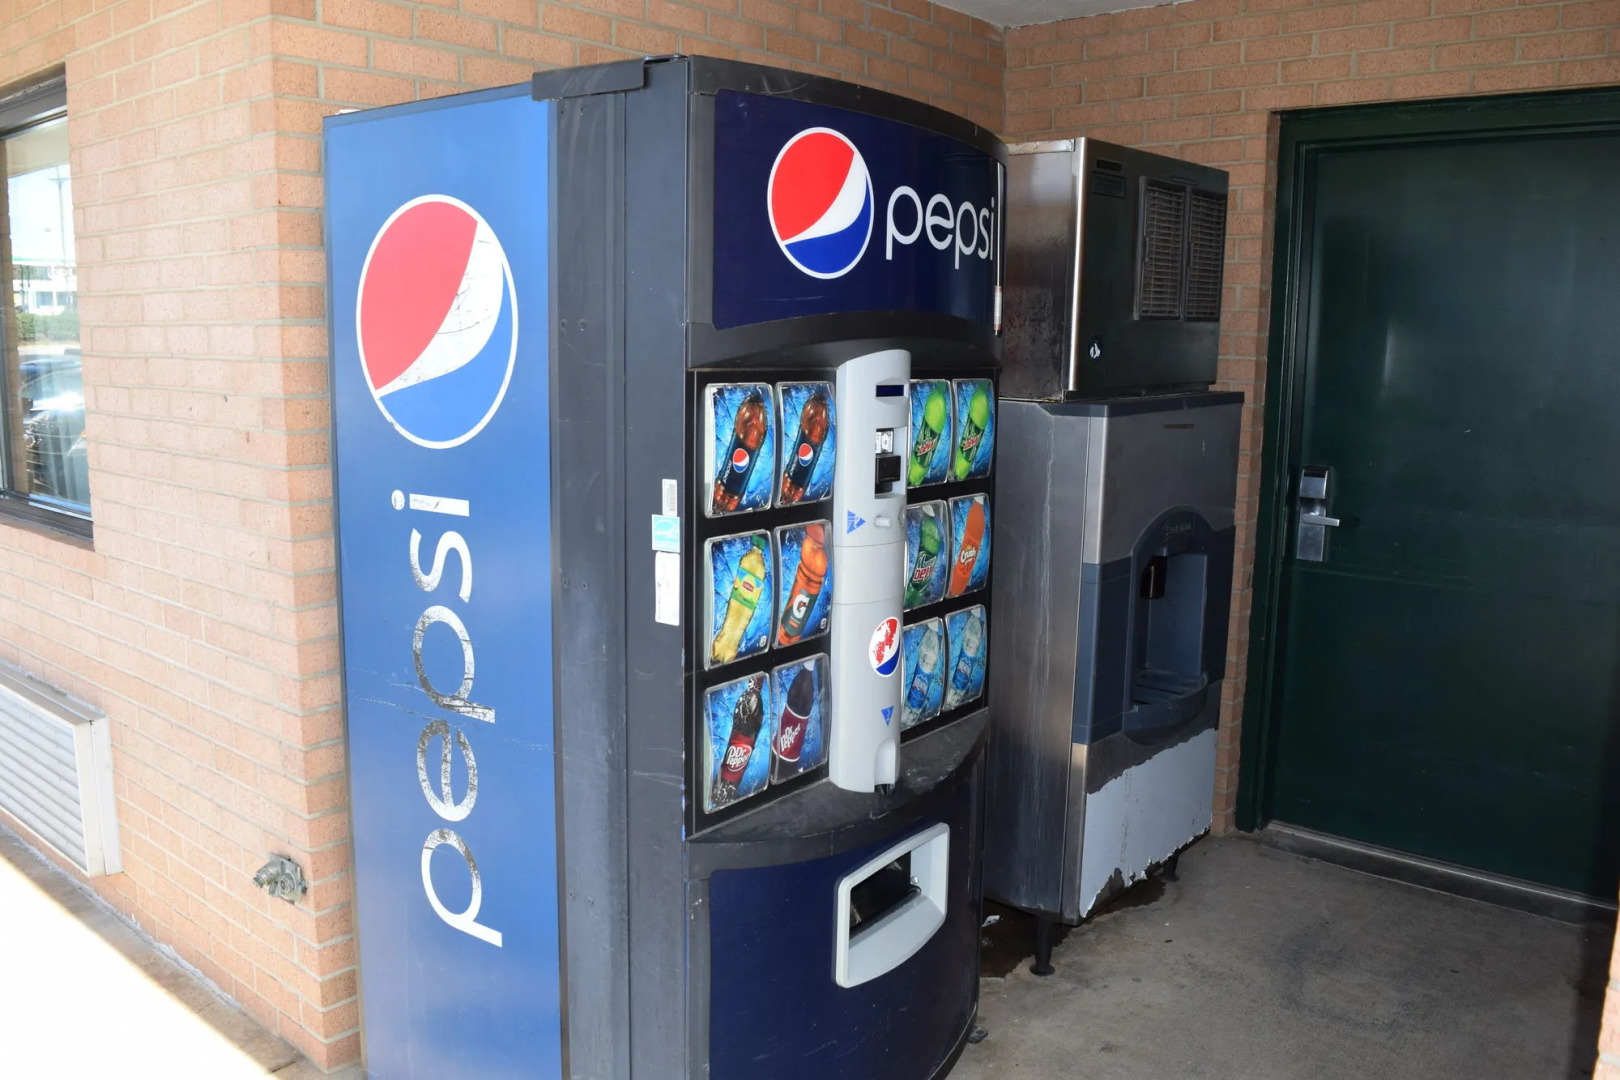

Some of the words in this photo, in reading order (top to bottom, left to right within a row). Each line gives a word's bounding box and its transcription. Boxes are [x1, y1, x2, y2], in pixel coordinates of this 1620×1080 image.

[886, 185, 995, 270] pepsi
[960, 547, 977, 563] Crush
[793, 594, 810, 619] G
[391, 489, 503, 948] pepsi
[780, 723, 801, 752] Pepper
[726, 745, 748, 769] Pepper
[735, 746, 747, 757] Dr
